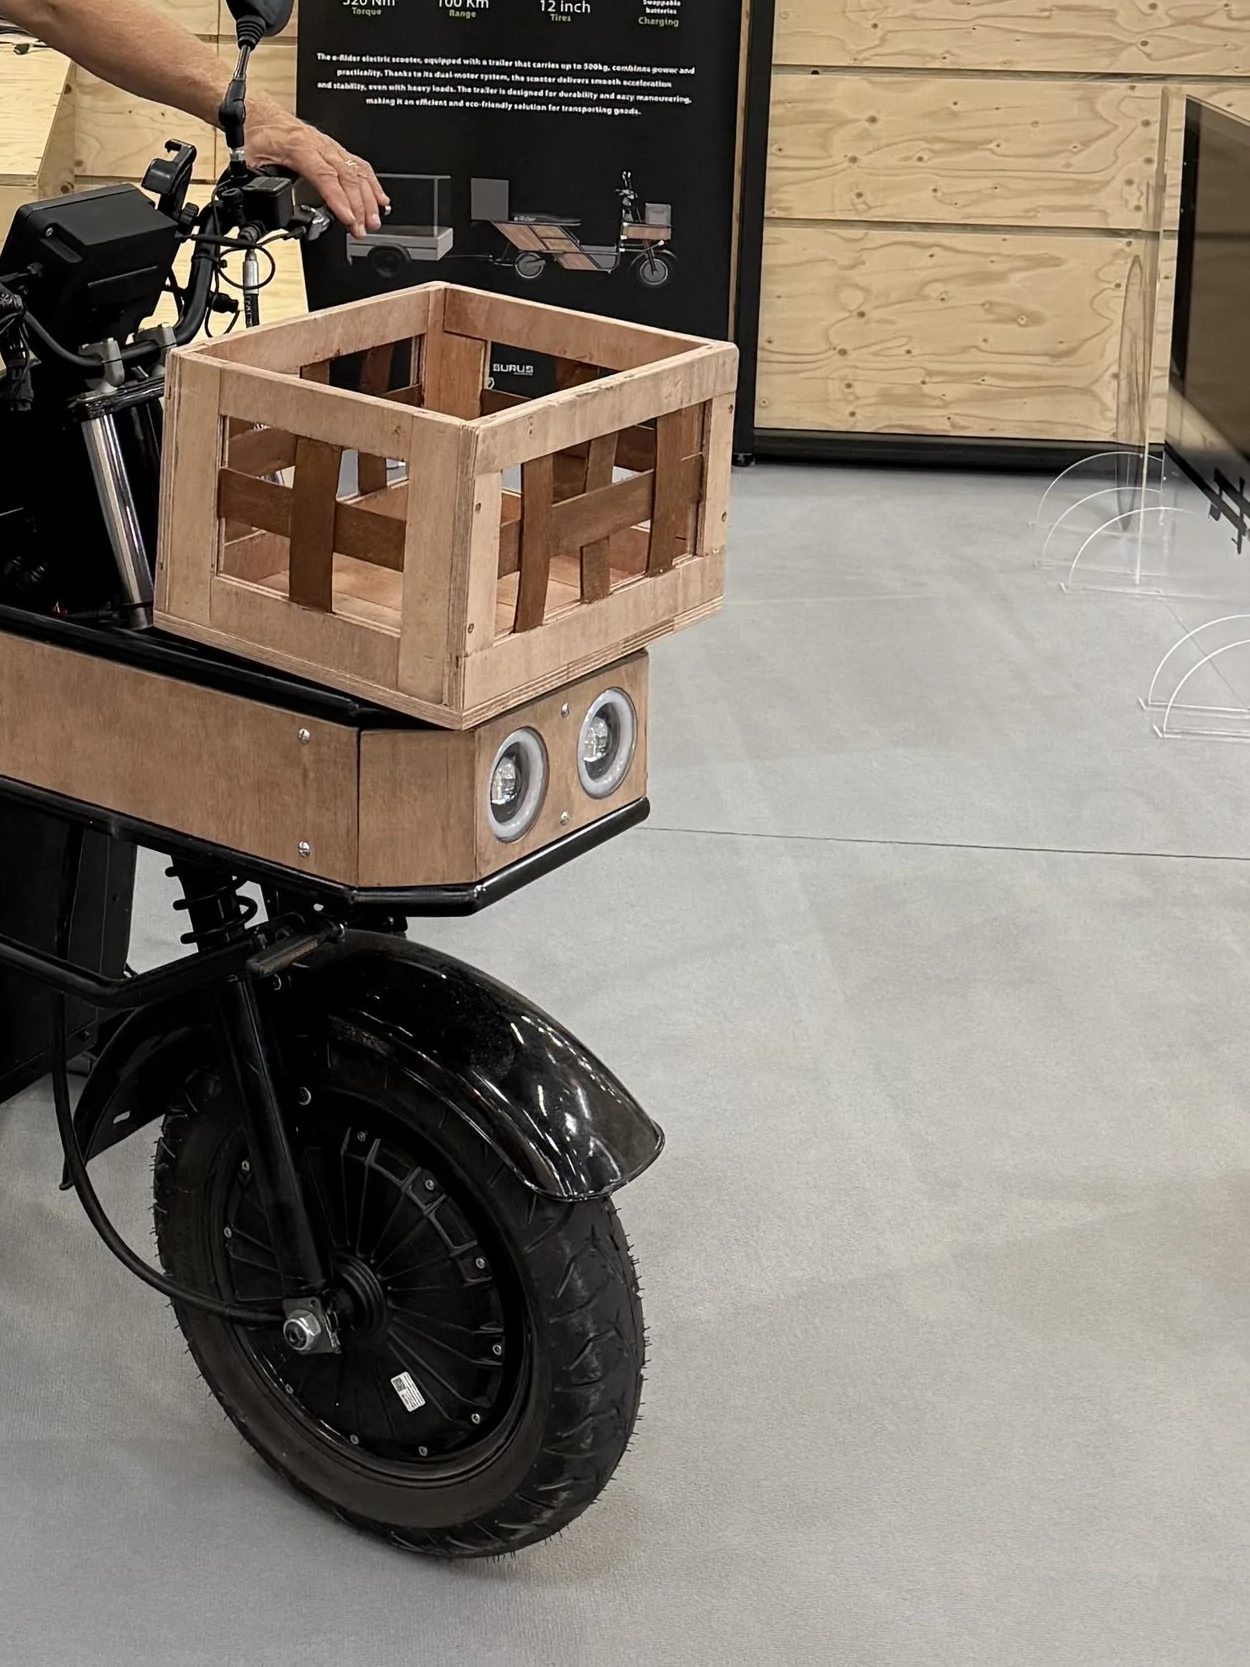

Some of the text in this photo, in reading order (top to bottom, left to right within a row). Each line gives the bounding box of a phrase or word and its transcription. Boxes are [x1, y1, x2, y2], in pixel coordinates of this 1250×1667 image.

[352, 7, 381, 16] Torque
[540, 0, 591, 13] 12 inch
[449, 10, 476, 19] Range
[550, 13, 571, 22] Tires
[638, 16, 679, 27] Charging
[317, 52, 330, 61] The
[361, 54, 390, 63] electric
[424, 56, 461, 66] equipped
[462, 57, 480, 65] with
[488, 58, 512, 67] trailer
[514, 59, 530, 68] that
[532, 61, 559, 69] carries
[384, 69, 411, 77] Thanks
[511, 73, 524, 81] the
[557, 75, 588, 84] delivers
[590, 77, 621, 85] smooth
[622, 78, 671, 88] acceleration
[317, 80, 332, 89] and
[388, 83, 406, 91] with
[407, 84, 430, 93] heavy
[457, 85, 471, 93] The
[473, 85, 497, 94] trailer
[507, 87, 543, 98] designed
[545, 89, 556, 97] for
[558, 89, 597, 100] durability
[599, 91, 615, 99] and
[365, 96, 395, 106] making
[415, 97, 447, 106] efficient
[448, 98, 463, 107] and
[465, 99, 512, 111] eco-friendly
[514, 102, 546, 111] solution
[548, 103, 559, 111] for
[561, 104, 612, 115] transporting
[493, 363, 534, 373] SURUS
